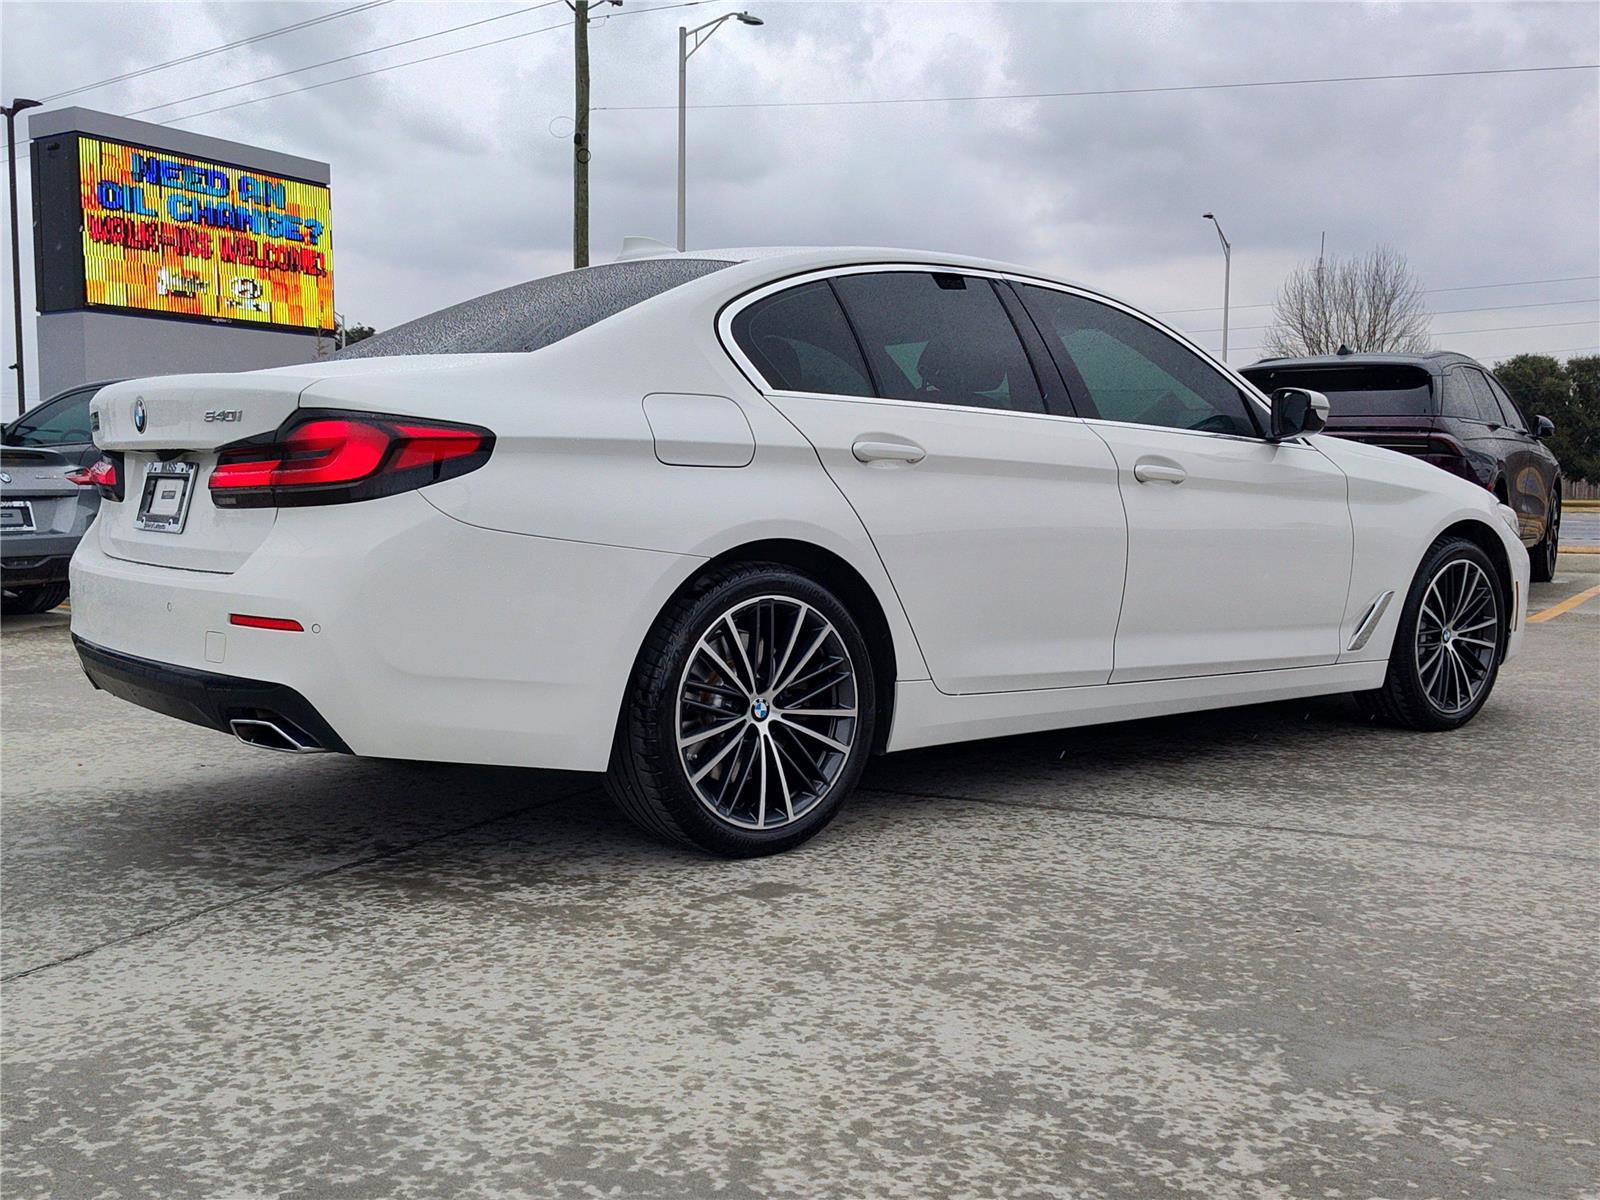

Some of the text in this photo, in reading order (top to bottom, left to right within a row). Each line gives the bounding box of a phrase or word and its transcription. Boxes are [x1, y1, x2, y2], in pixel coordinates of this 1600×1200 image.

[131, 152, 286, 210] NEED AN
[87, 214, 213, 260] WALK-INS
[97, 180, 324, 246] OIL CHANGE?
